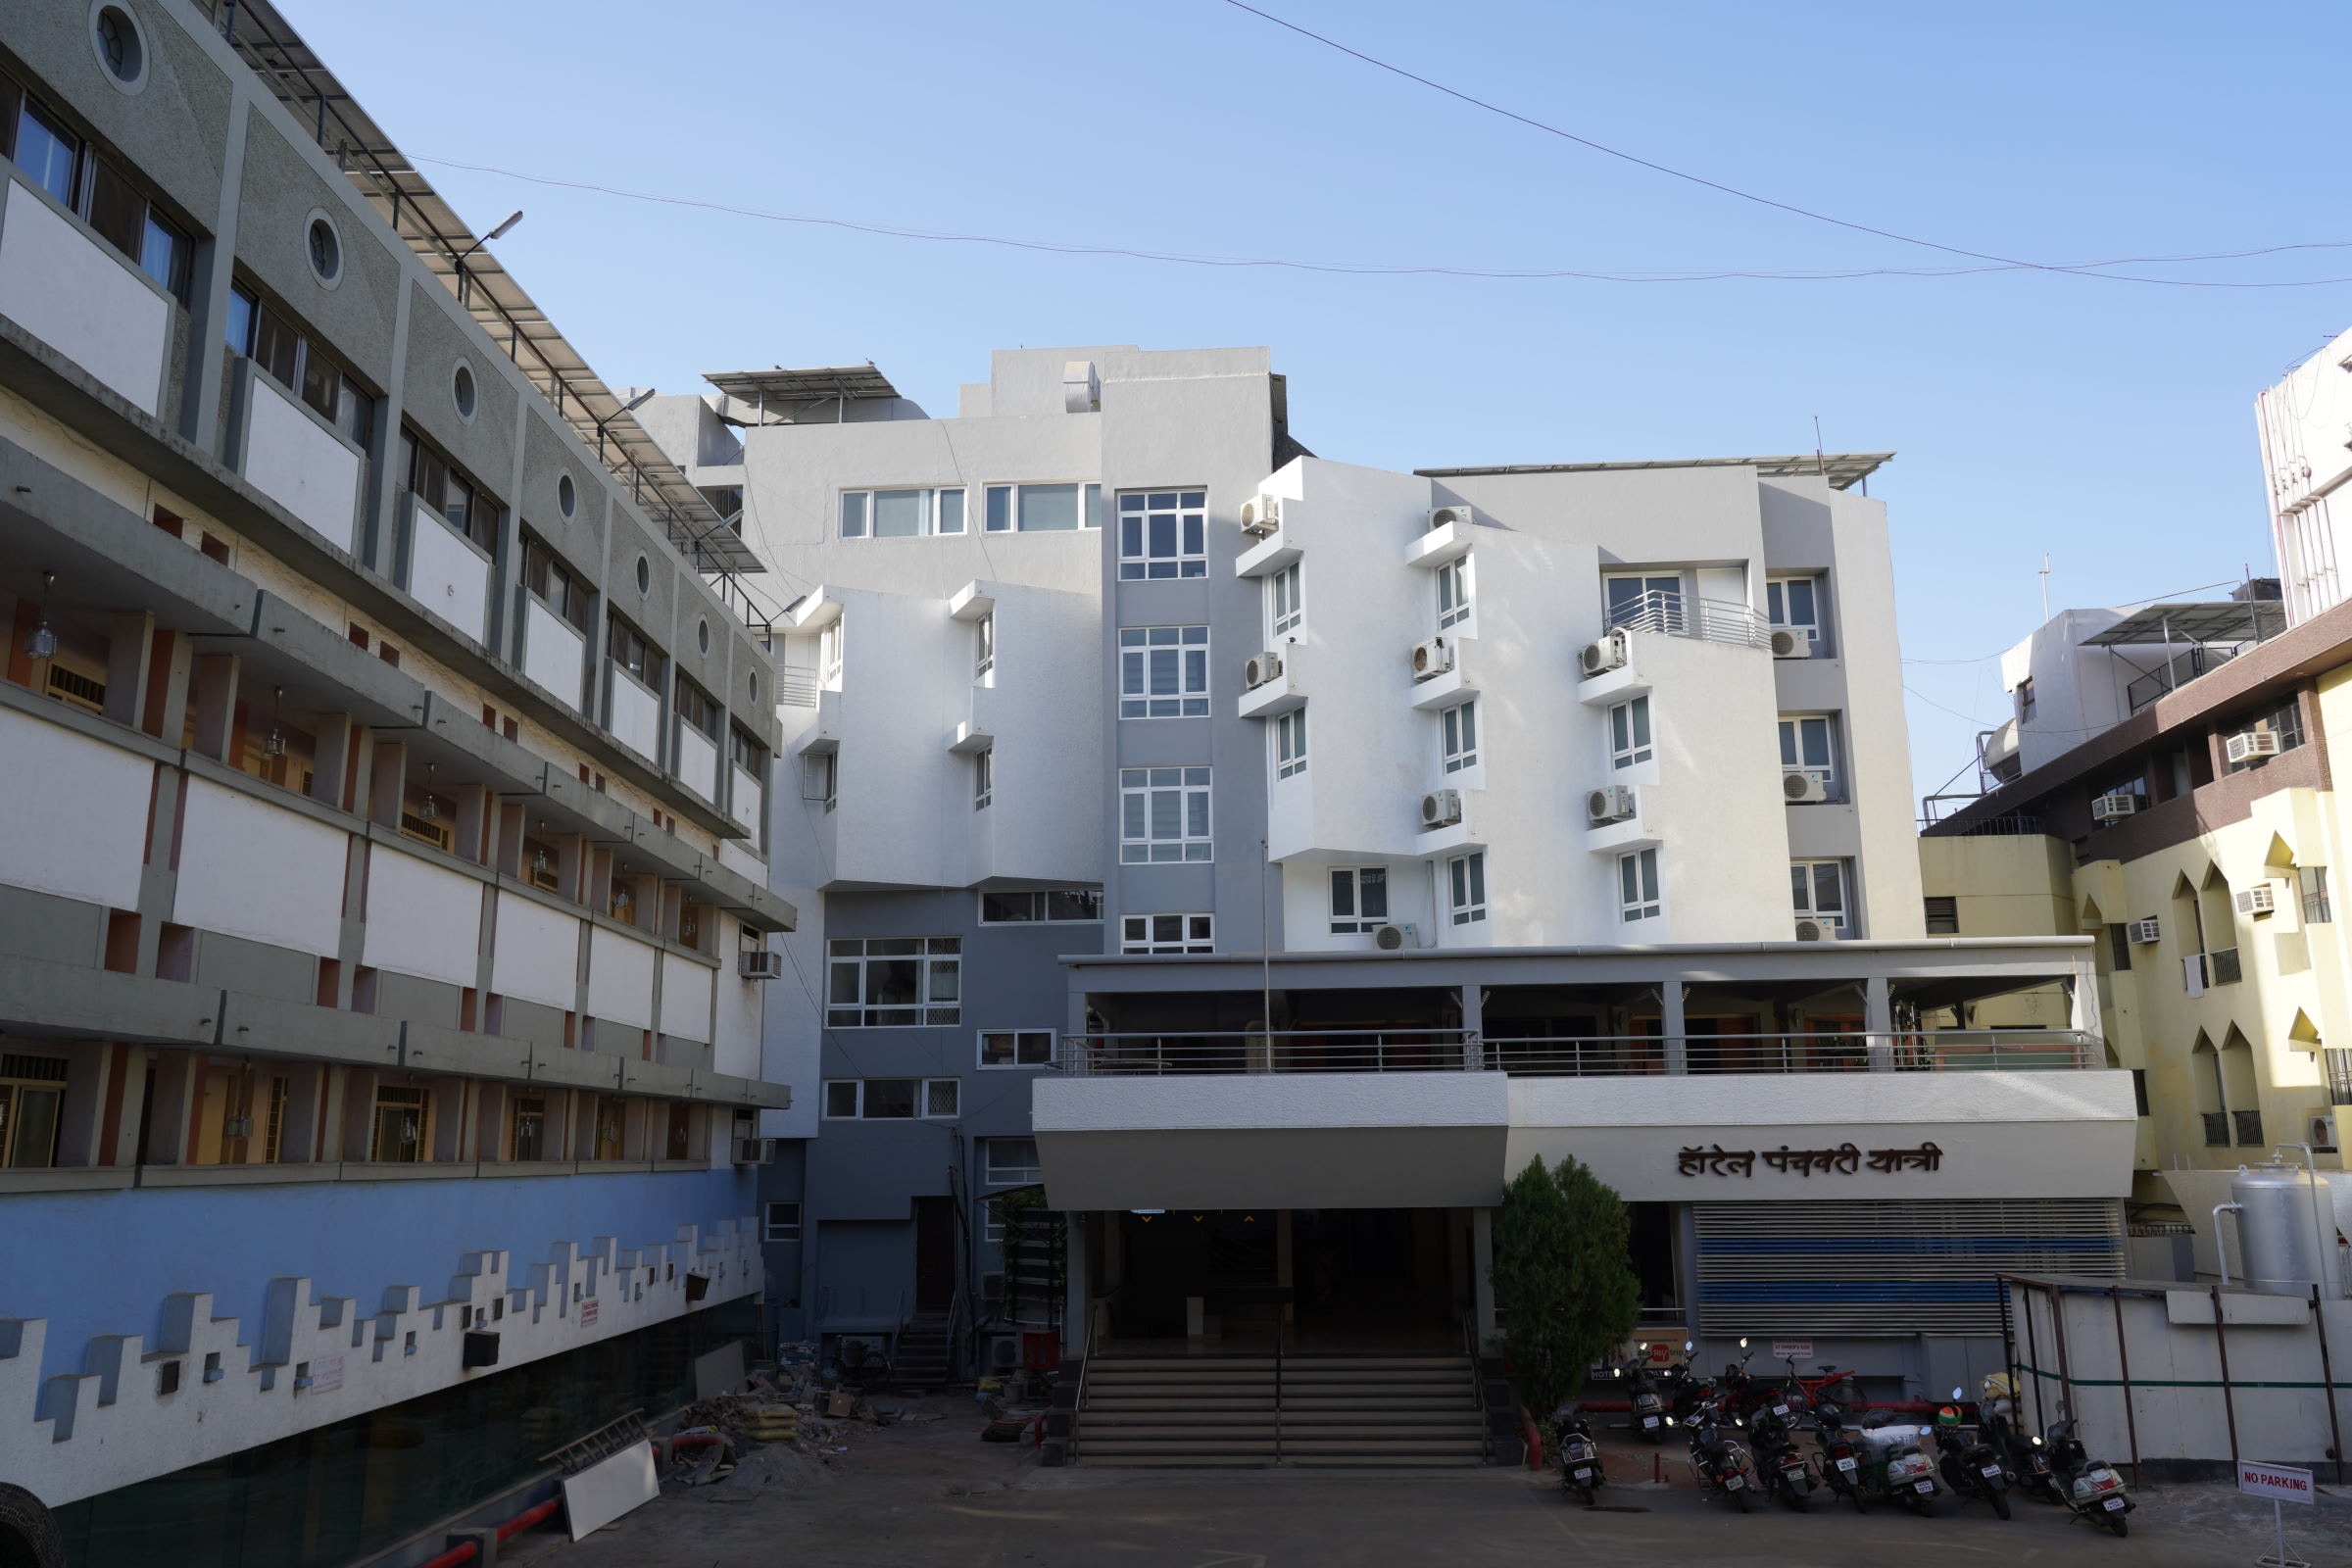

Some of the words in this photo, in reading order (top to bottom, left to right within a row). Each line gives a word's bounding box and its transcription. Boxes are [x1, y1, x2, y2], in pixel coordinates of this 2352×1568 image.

[1679, 1144, 1756, 1177] हॉटेल
[1762, 1142, 1861, 1178] पंचवटी
[1866, 1142, 1943, 1174] यात्री
[1653, 1348, 1668, 1361] my
[1670, 1349, 1684, 1358] trip
[2244, 1472, 2259, 1484] NO
[2261, 1474, 2308, 1491] PARKING
